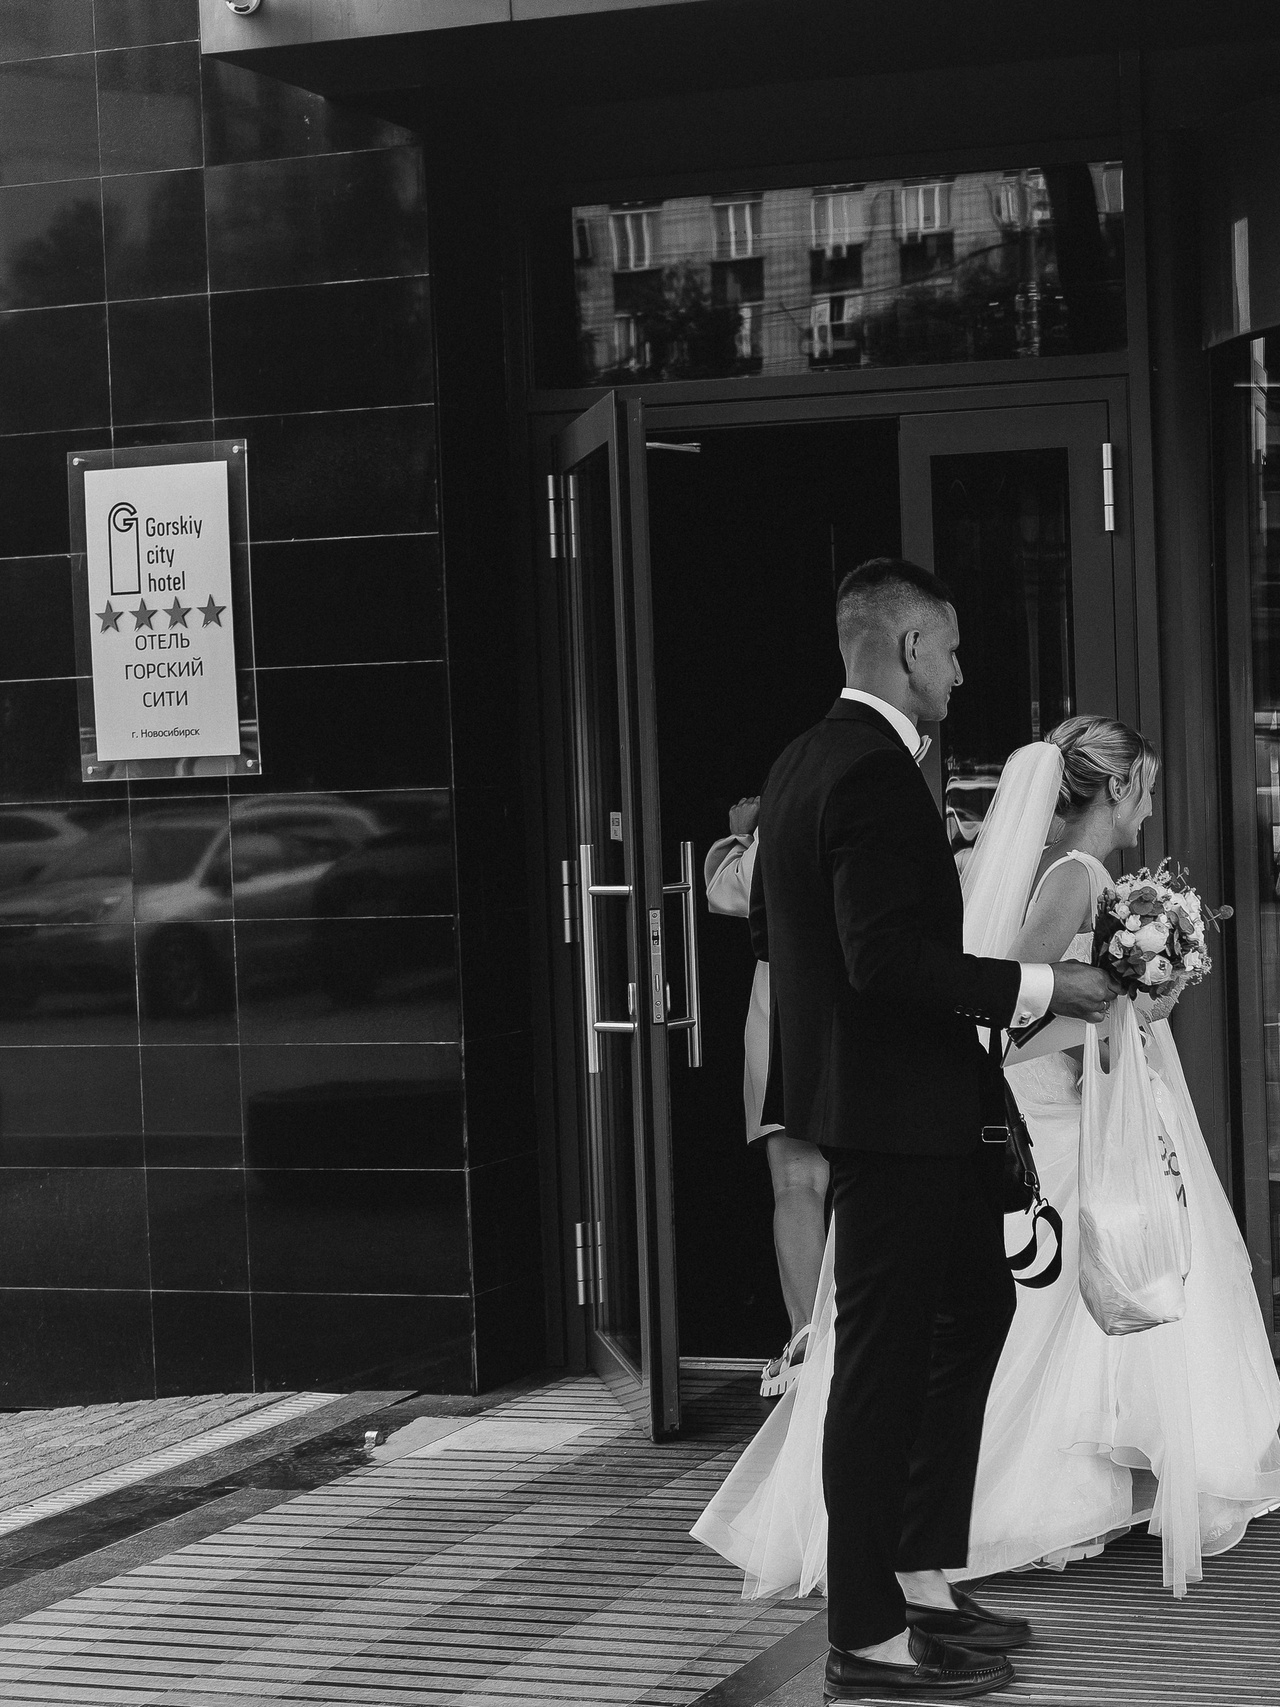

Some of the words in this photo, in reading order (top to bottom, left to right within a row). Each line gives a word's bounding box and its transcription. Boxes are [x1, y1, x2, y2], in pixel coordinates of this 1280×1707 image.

[145, 514, 203, 538] Gorskiy
[146, 545, 175, 568] city
[148, 570, 186, 593] hotel
[135, 632, 190, 651] ОТЕЛЬ
[125, 656, 204, 680] ГОРСКИЙ
[142, 690, 188, 708] СИТИ
[131, 731, 139, 739] г.
[141, 726, 201, 739] Новосибирск
